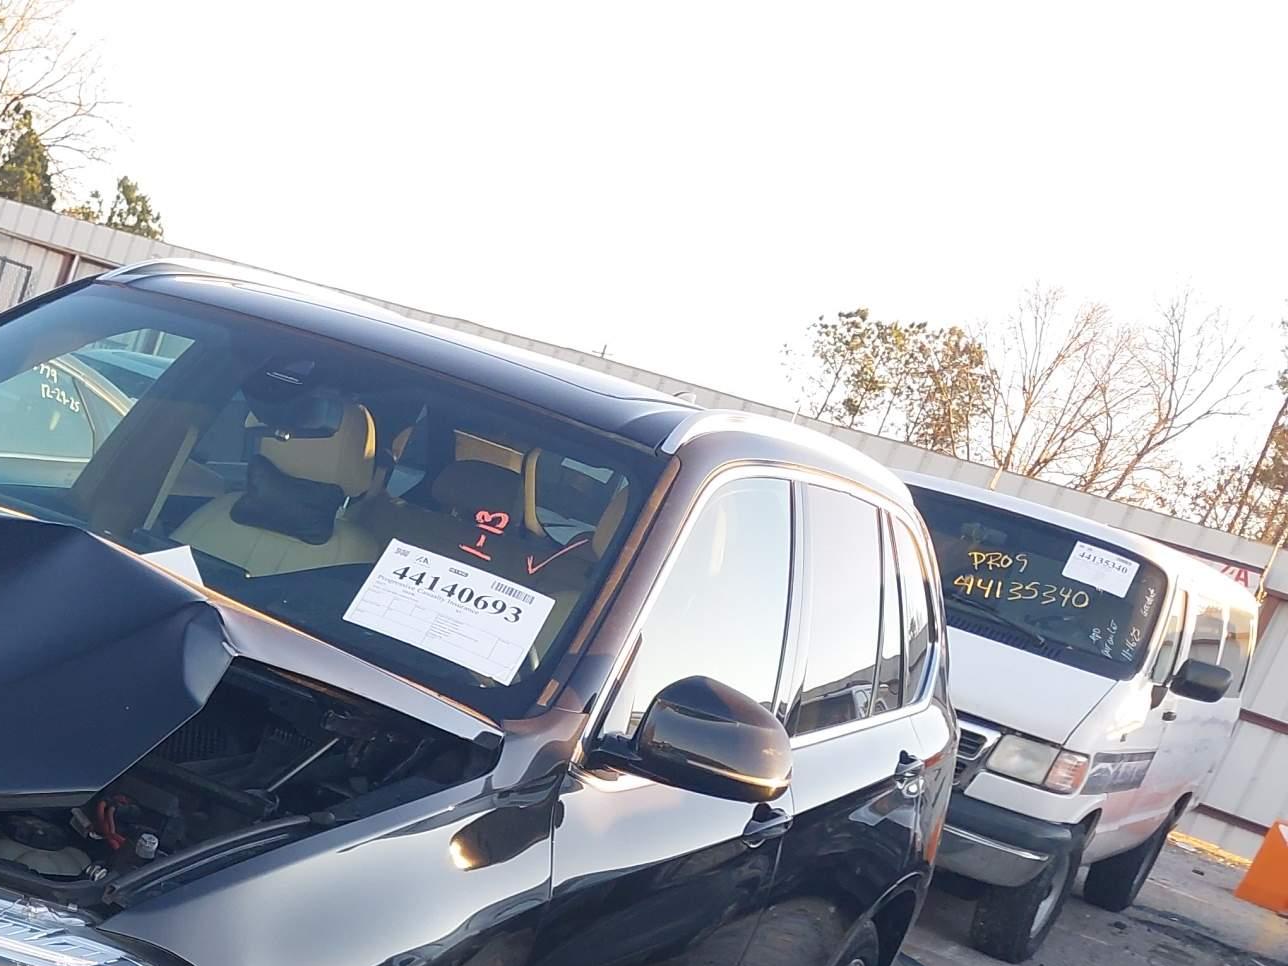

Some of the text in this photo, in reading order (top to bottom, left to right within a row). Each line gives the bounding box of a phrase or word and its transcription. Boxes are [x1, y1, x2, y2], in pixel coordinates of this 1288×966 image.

[1078, 551, 1128, 574] 44135340
[392, 566, 523, 623] 44140693
[953, 573, 1090, 608] 44135340
